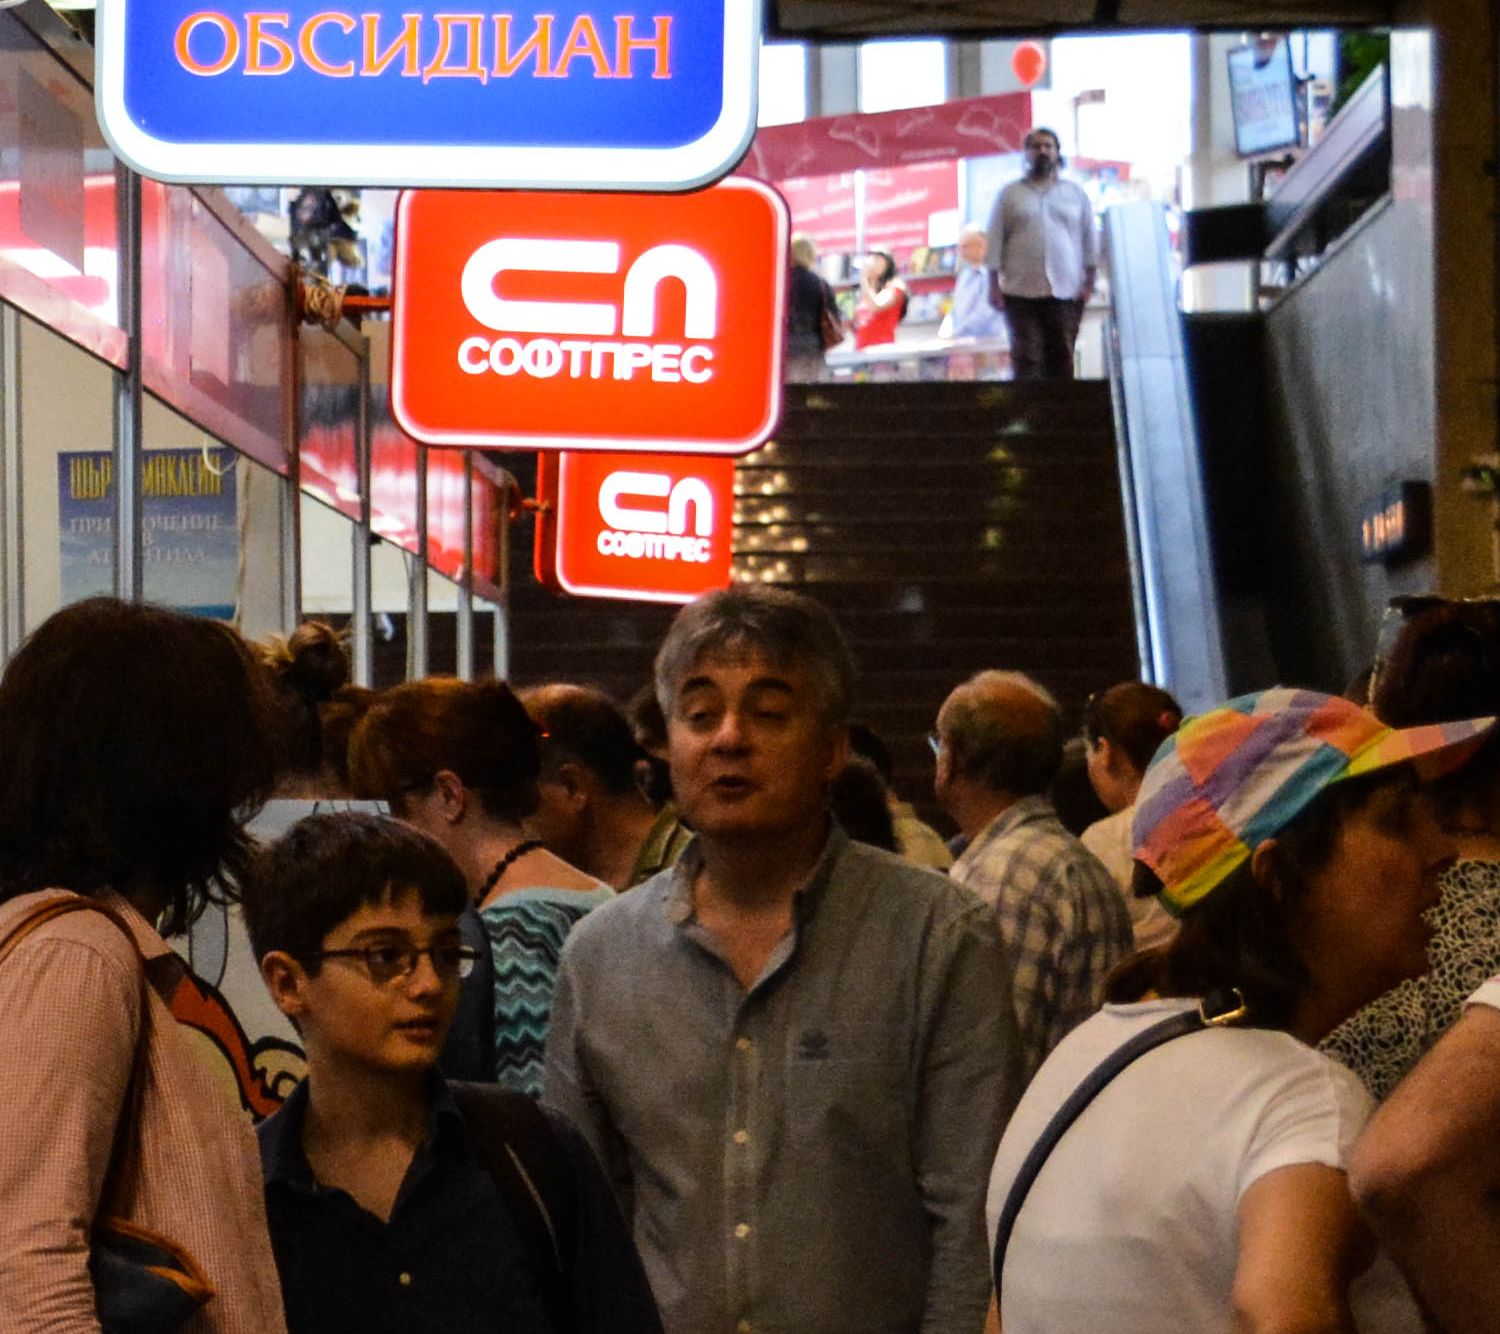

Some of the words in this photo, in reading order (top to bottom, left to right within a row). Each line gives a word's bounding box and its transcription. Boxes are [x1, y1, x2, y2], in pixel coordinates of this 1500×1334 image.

[173, 10, 674, 86] ОБСИДИАН
[457, 337, 714, 383] СОФТПРЕС
[597, 530, 711, 563] СОФТПРЕС
